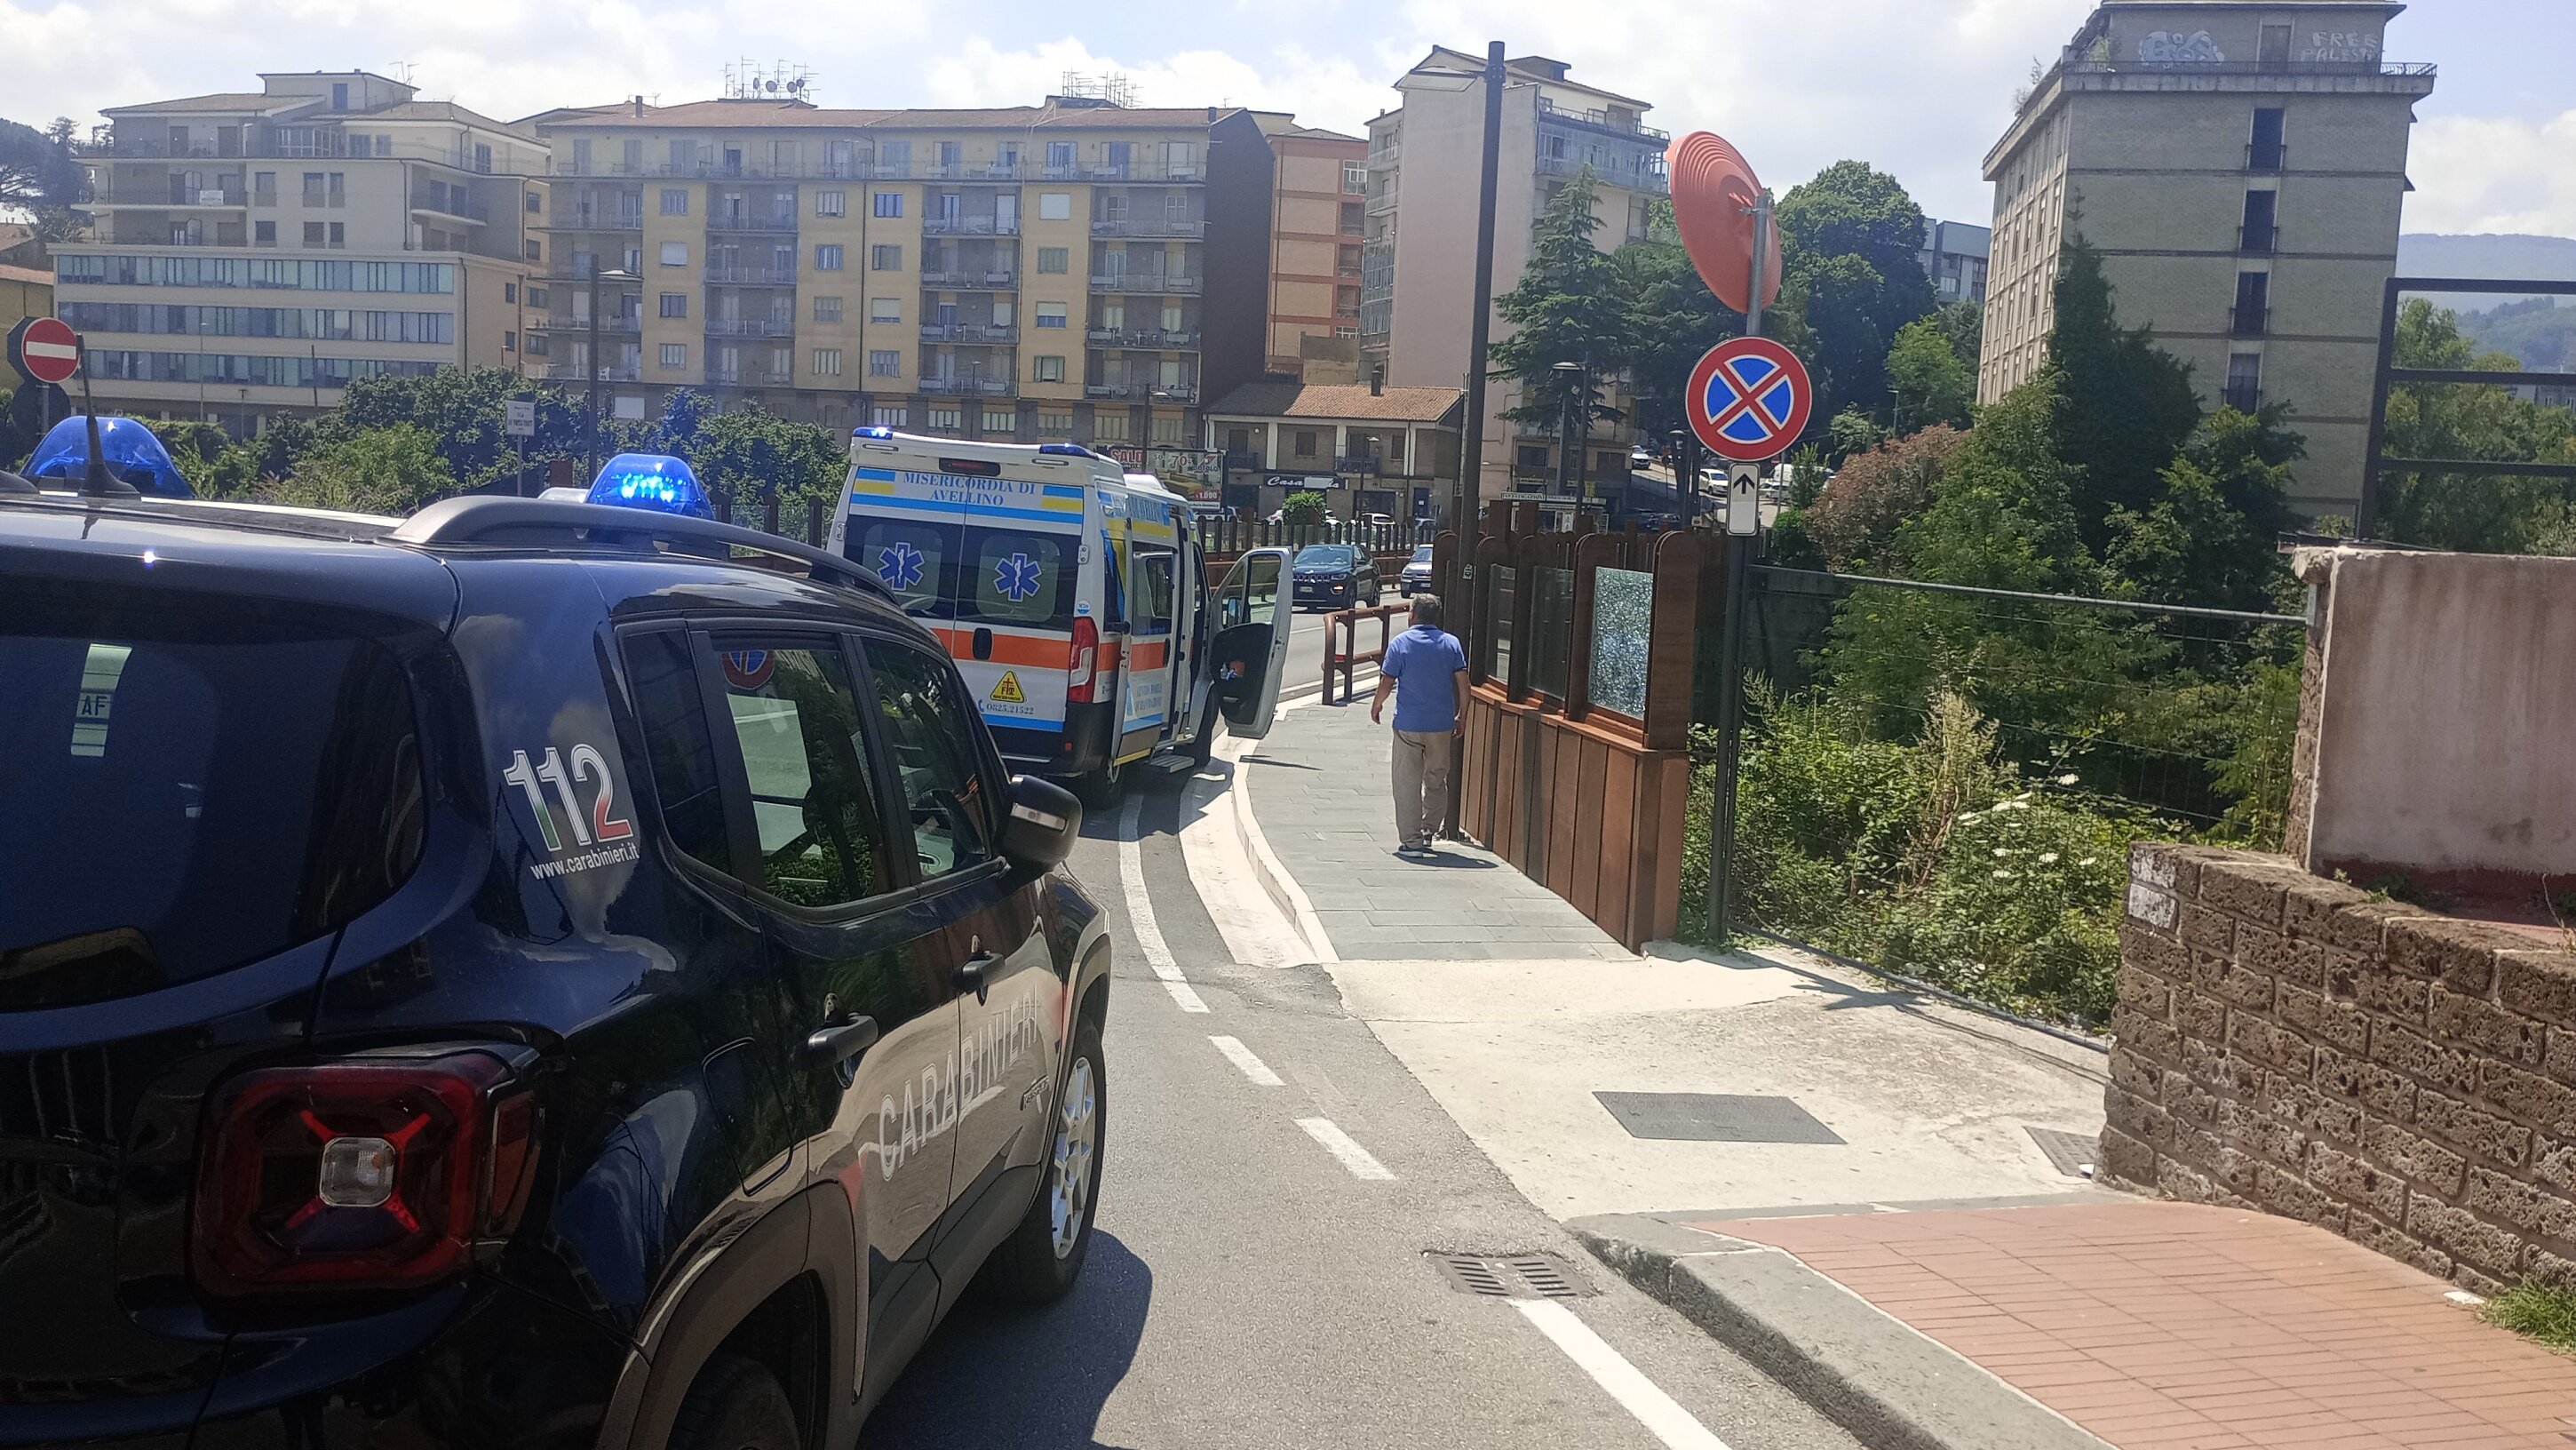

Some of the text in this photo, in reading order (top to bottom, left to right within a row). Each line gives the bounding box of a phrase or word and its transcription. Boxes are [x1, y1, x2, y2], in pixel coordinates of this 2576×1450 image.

[2312, 31, 2377, 48] FREE
[902, 473, 1036, 495] MISERICORDIA DI
[1267, 476, 1303, 486] Casa
[929, 490, 1005, 506] AVELLINO
[81, 695, 107, 716] AF
[986, 703, 1034, 714] 0825.21522
[503, 743, 633, 852] 112
[530, 841, 640, 880] www.carabinieri.it
[879, 984, 1038, 1181] CARABINIERI
